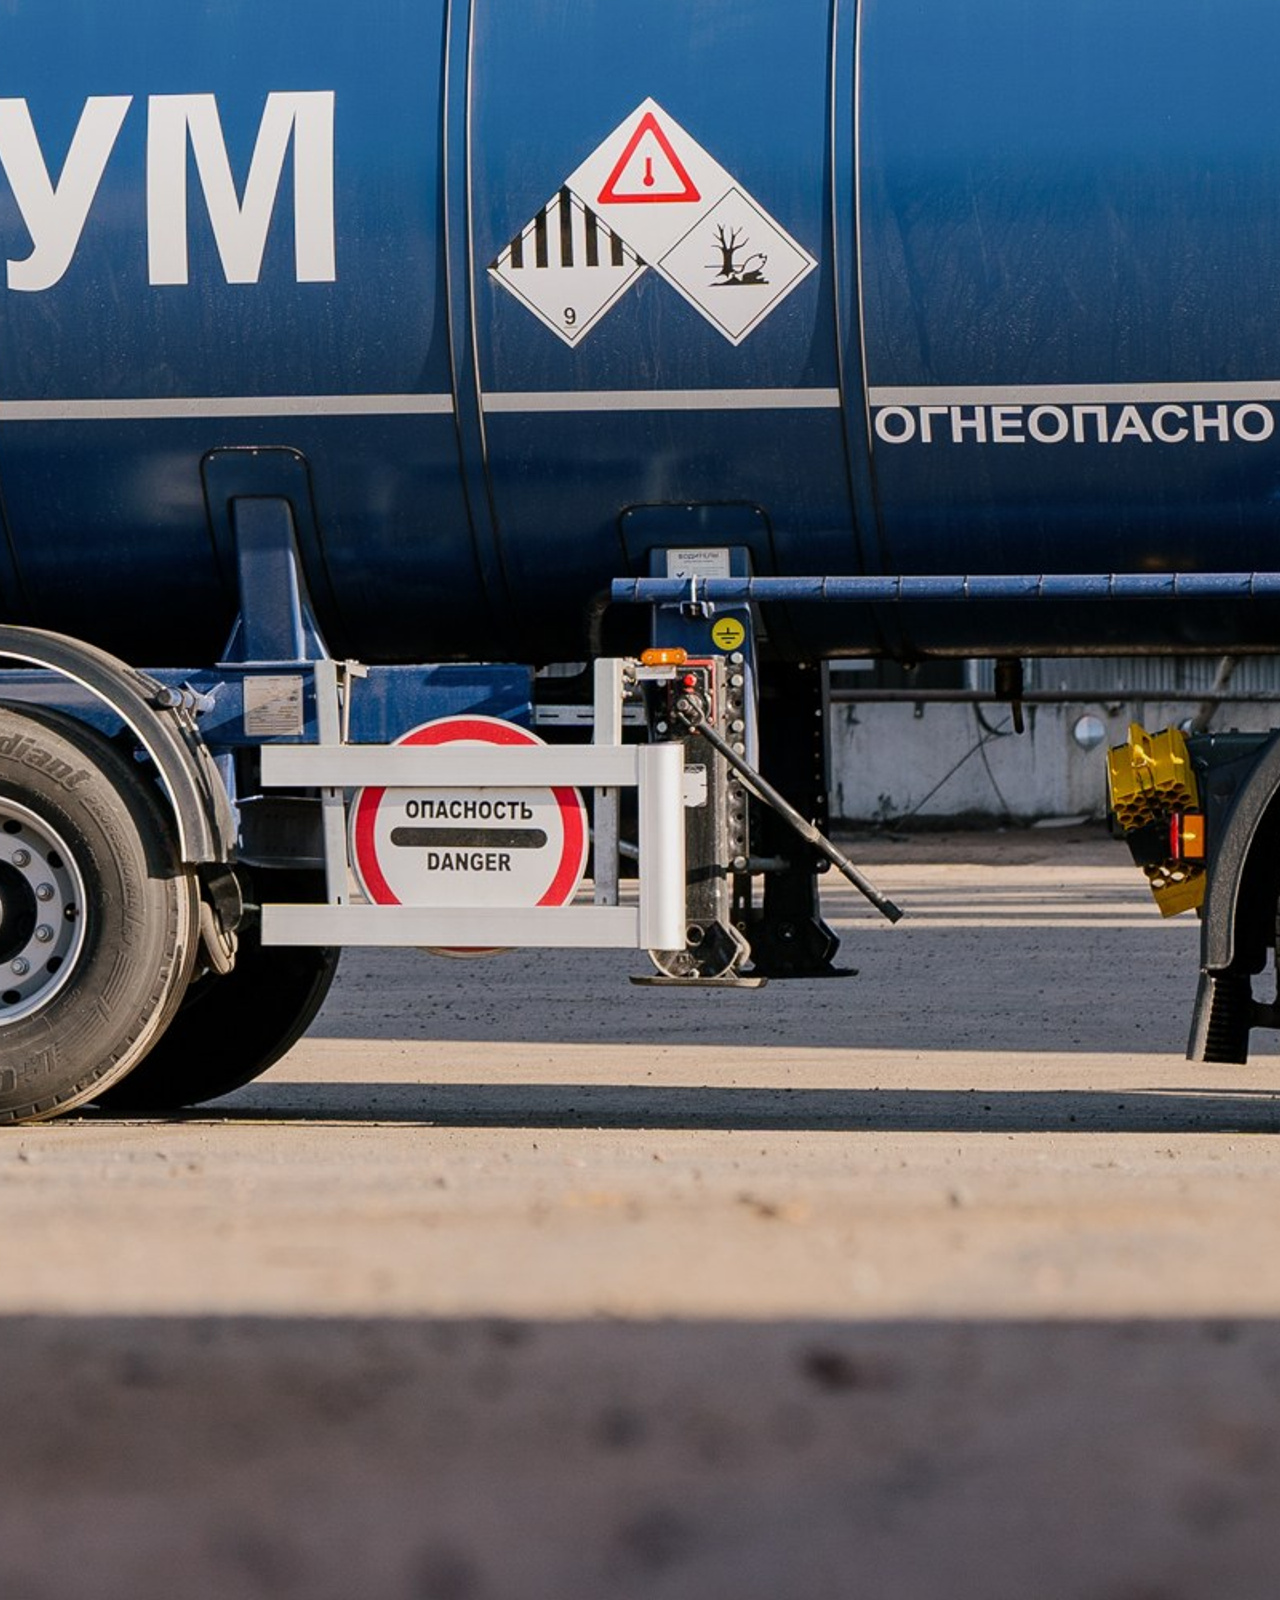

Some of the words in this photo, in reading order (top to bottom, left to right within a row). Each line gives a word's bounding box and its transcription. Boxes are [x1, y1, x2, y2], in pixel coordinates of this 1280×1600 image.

[563, 307, 577, 326] 9
[874, 402, 1275, 444] ОГНЕОПАСНО
[405, 800, 533, 820] ОПАСНОСТЬ
[427, 853, 511, 872] DANGER
